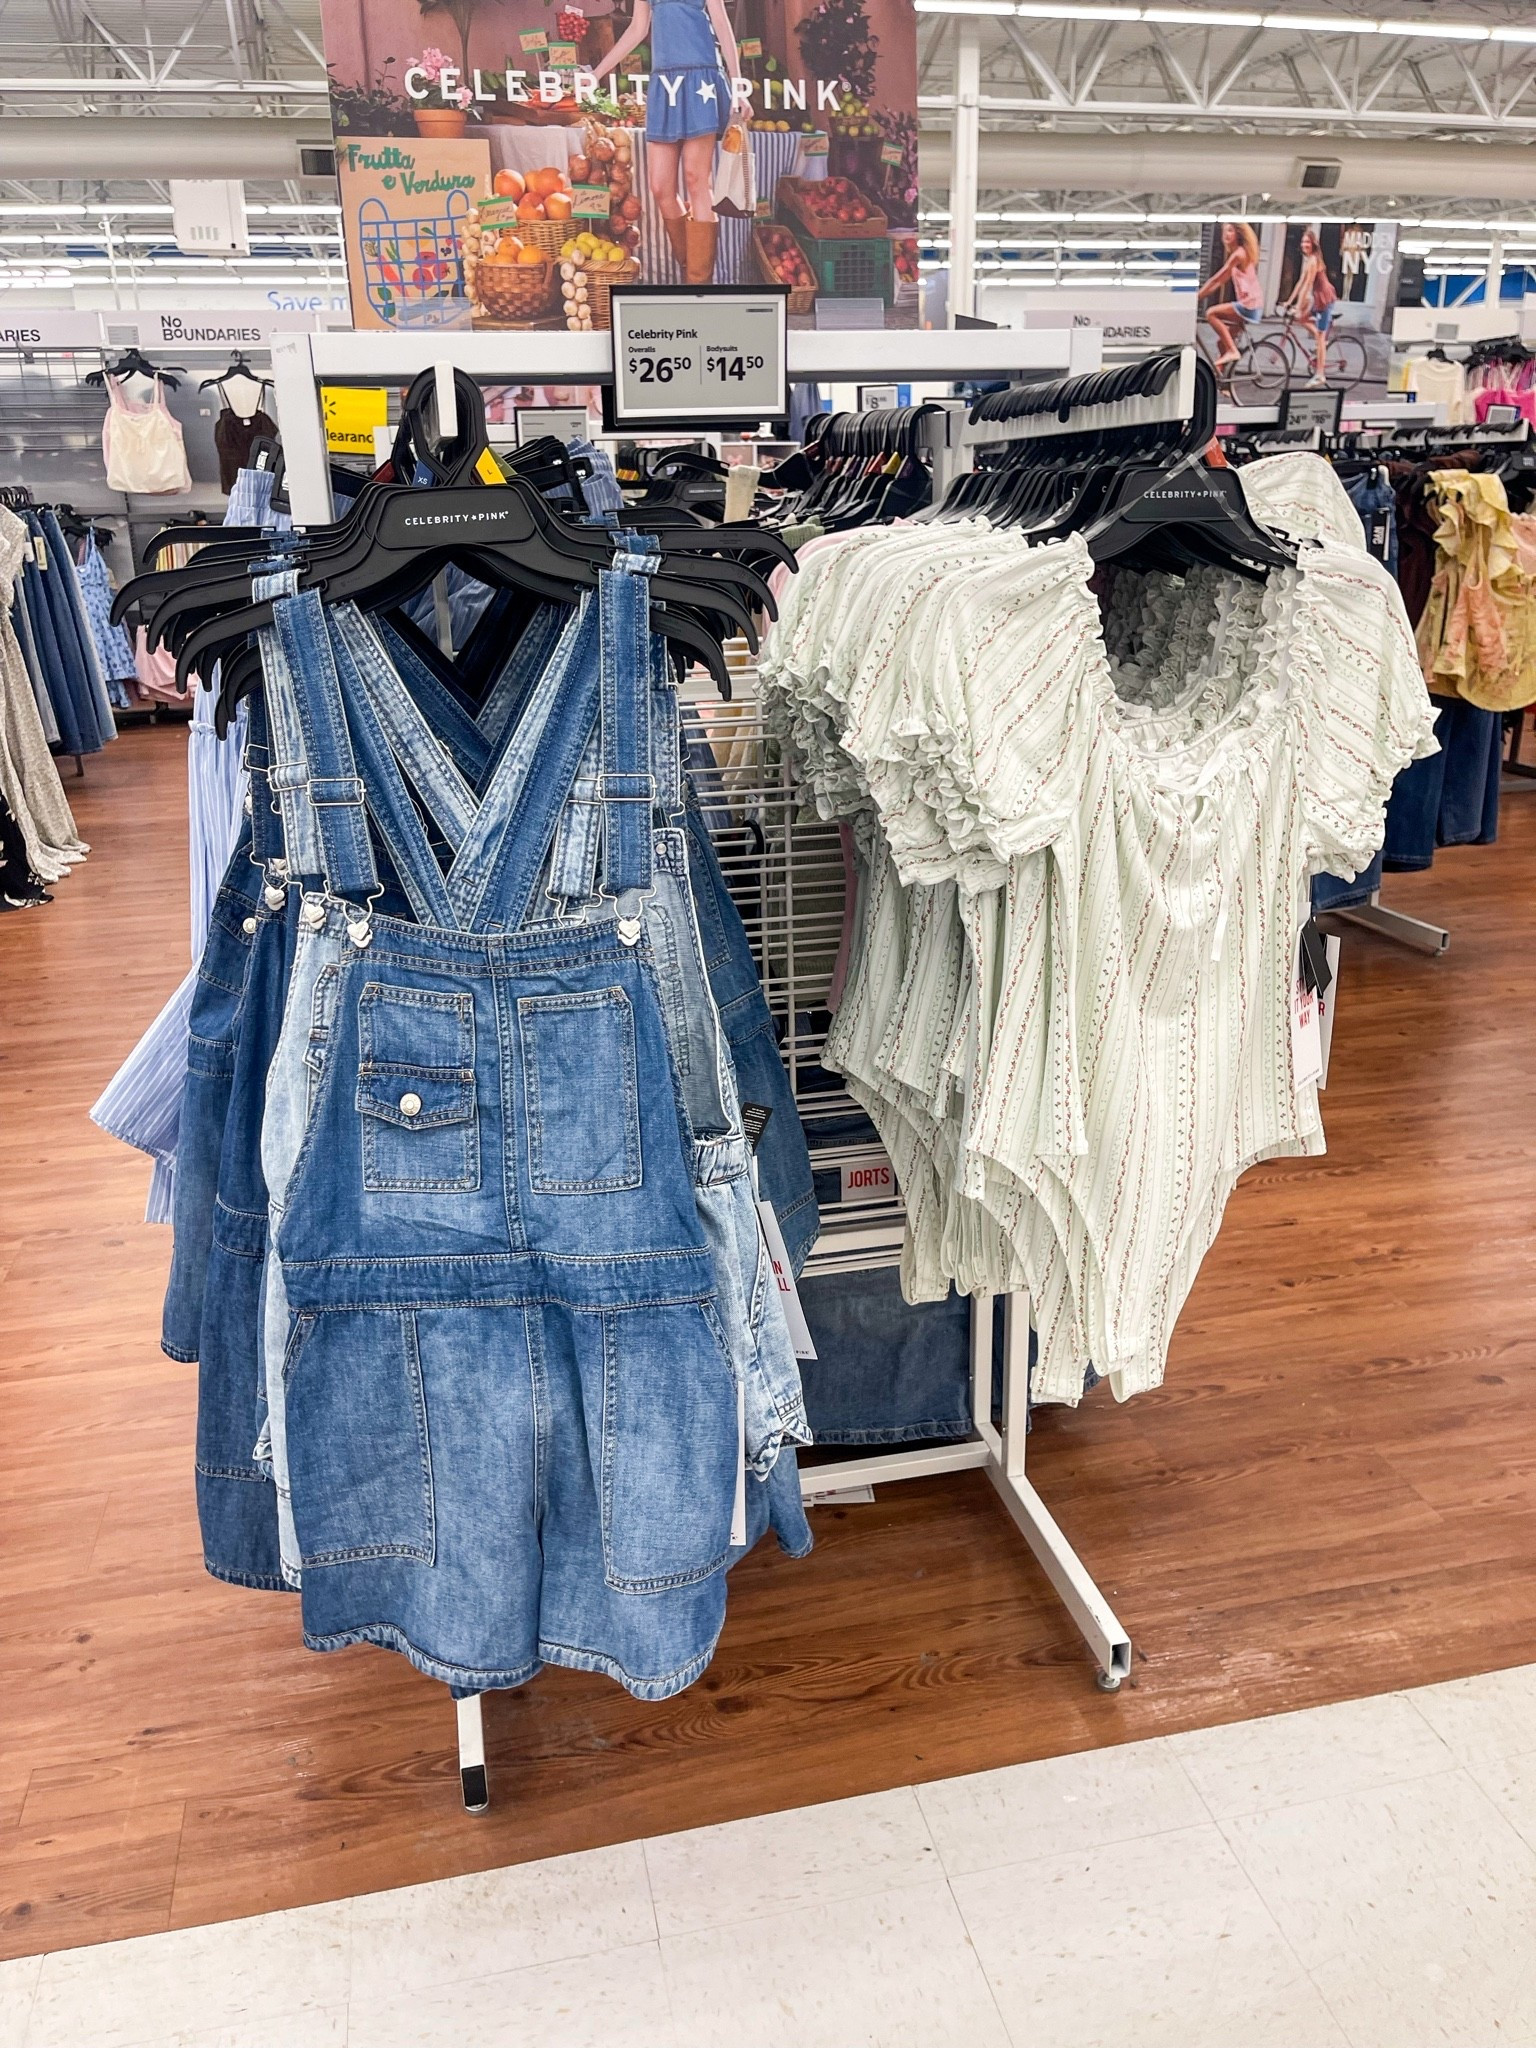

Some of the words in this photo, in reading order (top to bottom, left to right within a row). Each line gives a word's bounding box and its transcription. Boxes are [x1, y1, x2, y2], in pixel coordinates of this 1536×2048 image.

[404, 67, 684, 107] CELEBRITY
[347, 143, 415, 172] Frutta
[381, 175, 397, 190] e
[400, 170, 475, 196] Verdura
[1341, 250, 1394, 275] NYC
[160, 315, 182, 328] No
[628, 330, 673, 341] Celebrity
[676, 329, 698, 339] Pink
[628, 346, 656, 354] Overalls
[706, 345, 738, 353] Bodysuits
[417, 475, 428, 485] XS
[1143, 490, 1196, 499] CELEBRITY
[404, 514, 469, 526] CELEBRITY
[1299, 1010, 1311, 1030] WAY
[847, 1167, 890, 1189] JORTS
